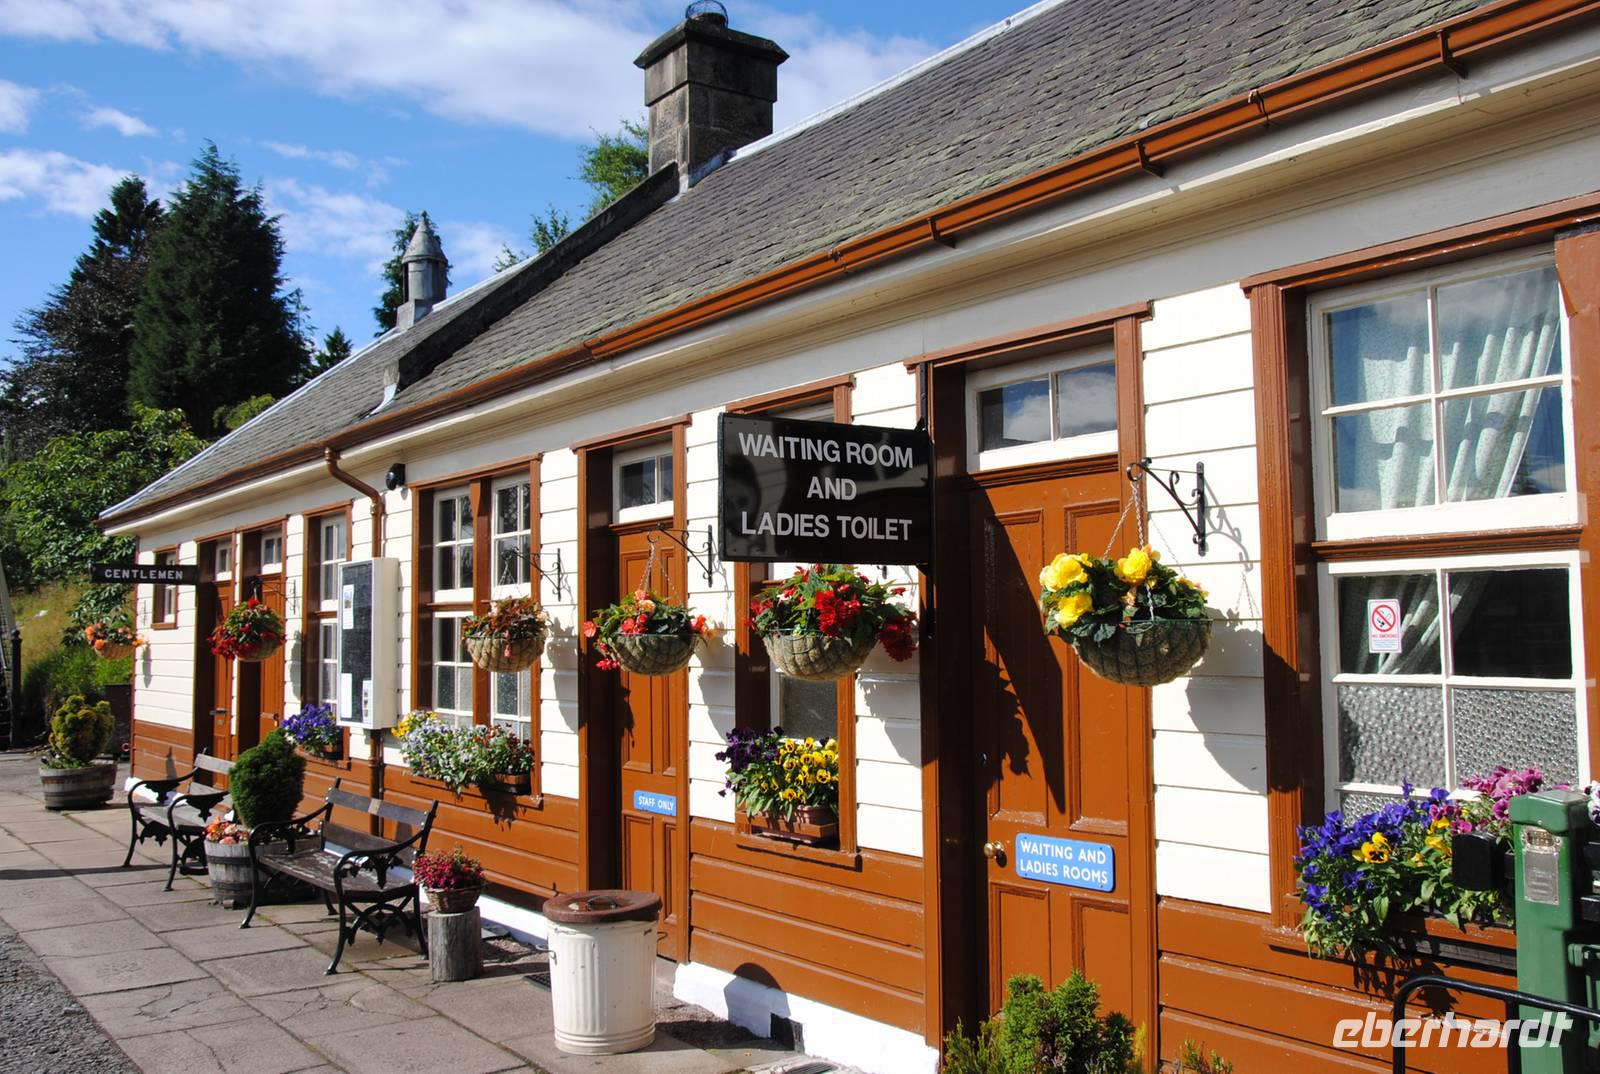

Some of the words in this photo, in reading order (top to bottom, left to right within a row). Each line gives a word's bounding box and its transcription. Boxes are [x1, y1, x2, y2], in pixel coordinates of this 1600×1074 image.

[739, 433, 840, 462] WAITING
[846, 442, 913, 468] ROOM
[807, 476, 857, 500] AND
[741, 511, 830, 538] LADIES
[837, 516, 912, 541] TOILET
[104, 569, 183, 580] GENTLEMEN
[638, 796, 656, 807] STAFF
[658, 800, 674, 810] ONLY
[1020, 841, 1073, 860] WAITING
[1078, 848, 1106, 865] AND
[1020, 859, 1058, 877] LADIES
[1063, 865, 1108, 884] ROOMS
